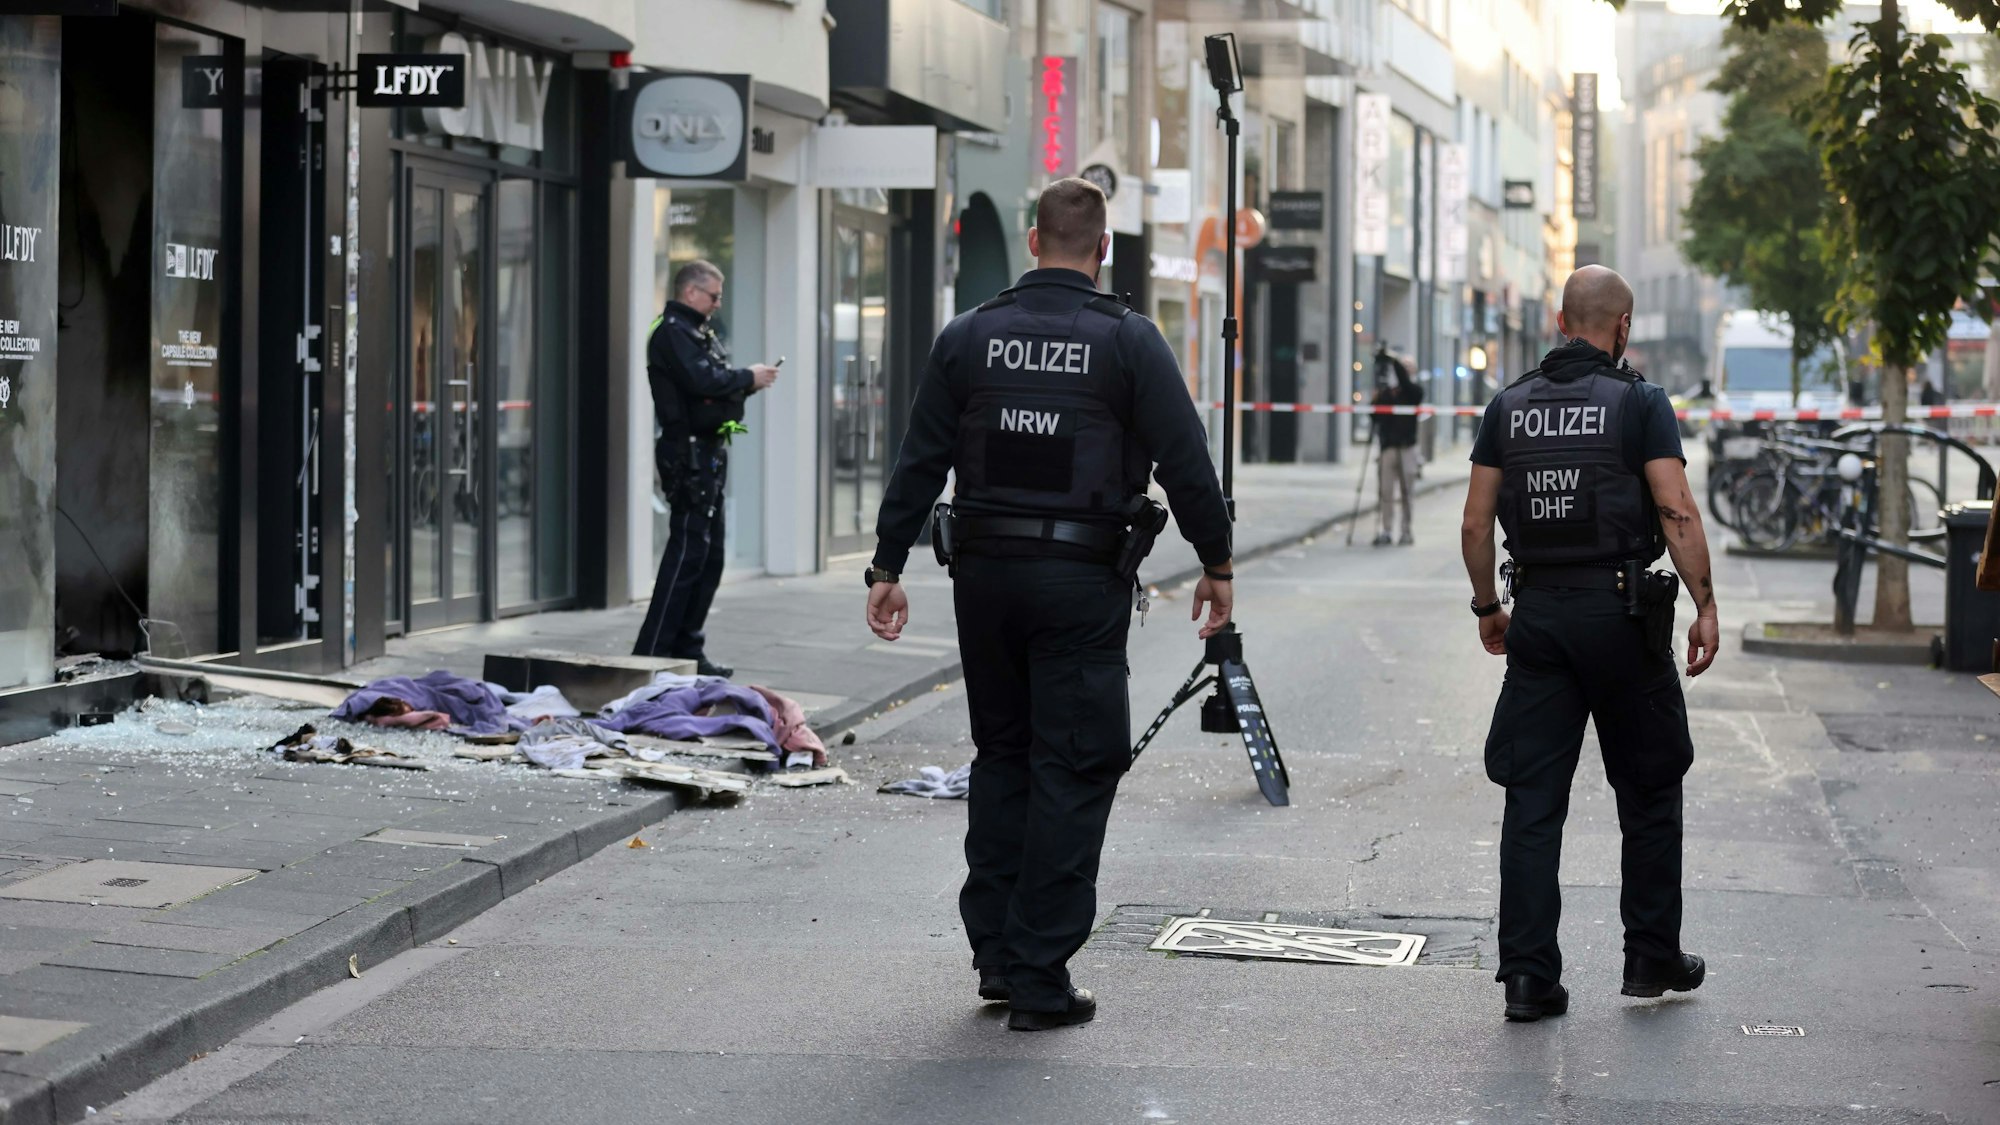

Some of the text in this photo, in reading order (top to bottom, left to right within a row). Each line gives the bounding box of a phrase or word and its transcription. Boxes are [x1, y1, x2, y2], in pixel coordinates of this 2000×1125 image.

[374, 65, 446, 95] LFDY
[640, 112, 733, 140] ONLY
[1364, 100, 1384, 252] ARKET
[5, 224, 38, 262] LFDY
[190, 246, 216, 281] LFDY
[5, 320, 19, 334] NEW
[0, 337, 40, 352] COLLECTION
[162, 344, 218, 360] CAPSULE COLLECTION
[987, 338, 1091, 374] POLIZEI
[1000, 408, 1060, 435] NRW
[1510, 406, 1606, 438] POLIZEI
[1527, 468, 1580, 493] NRW
[1531, 496, 1574, 519] DHF
